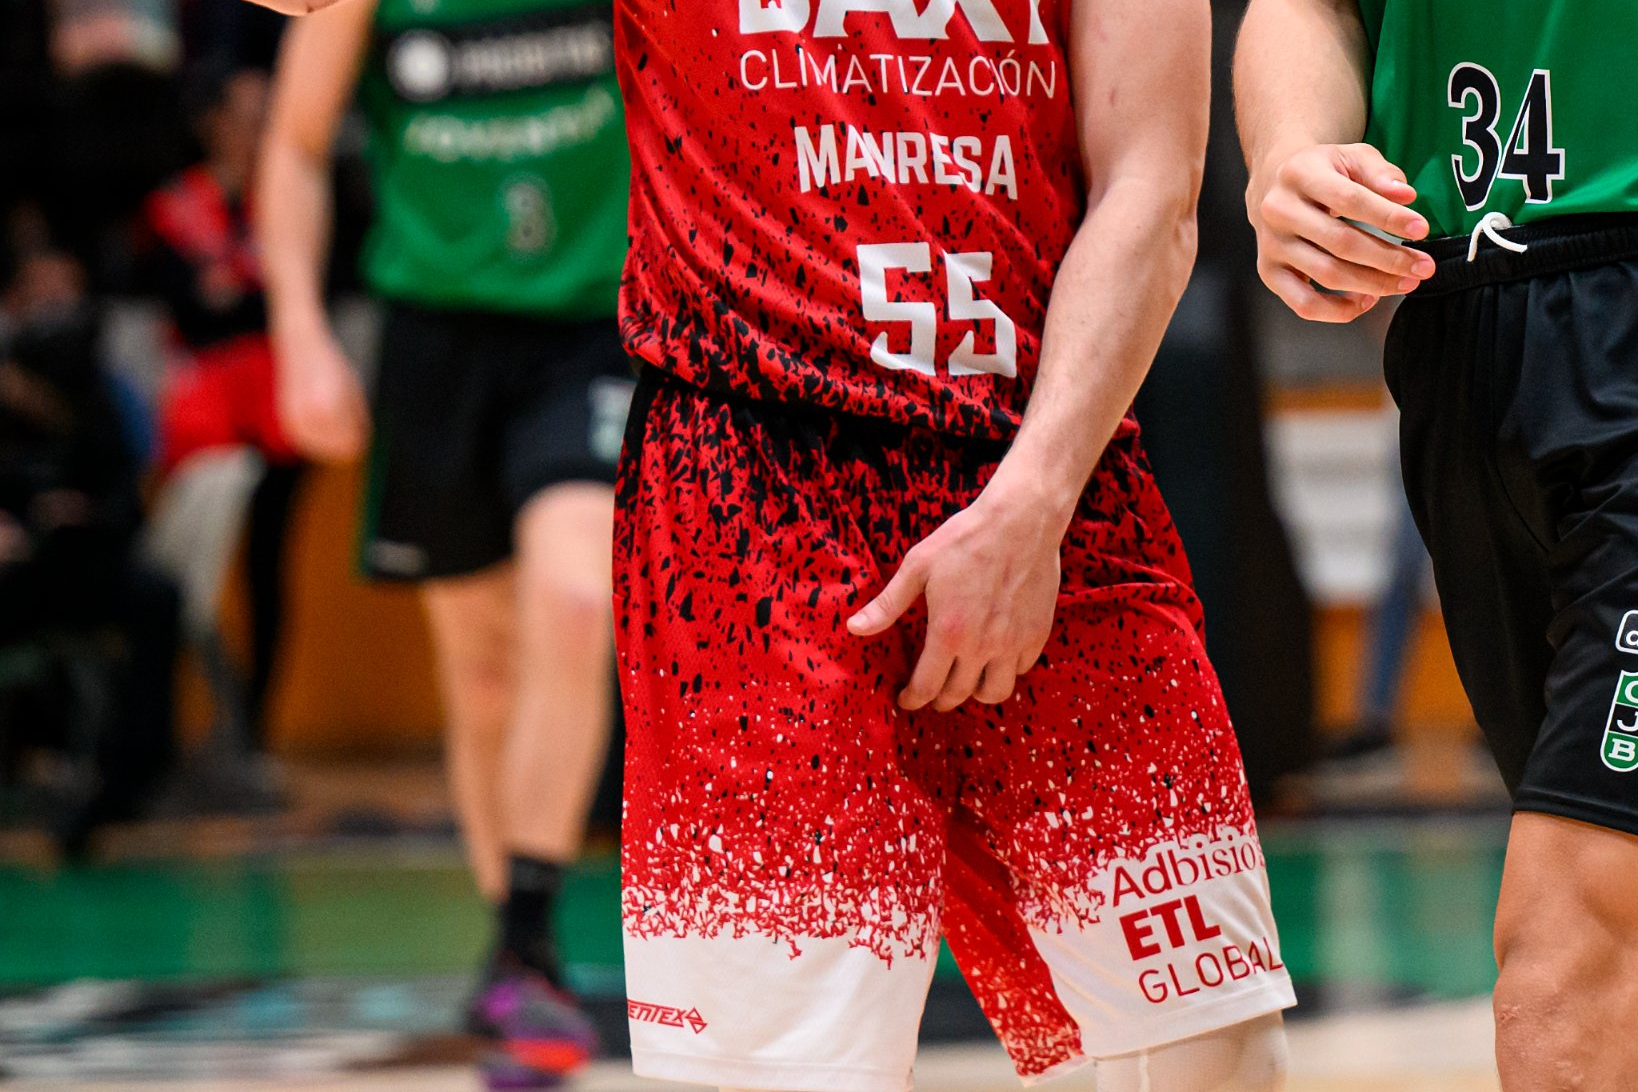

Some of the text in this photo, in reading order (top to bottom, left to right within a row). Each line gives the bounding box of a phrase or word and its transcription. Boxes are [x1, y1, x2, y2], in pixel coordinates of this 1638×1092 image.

[739, 43, 1056, 99] CLIMATIZACIÓN
[795, 123, 1018, 200] MANRESA
[1447, 62, 1566, 211] 34
[856, 241, 1017, 378] 55
[1119, 895, 1221, 961] ETL
[1138, 936, 1283, 1004] GLOBAL
[626, 999, 687, 1027] ENTEX
